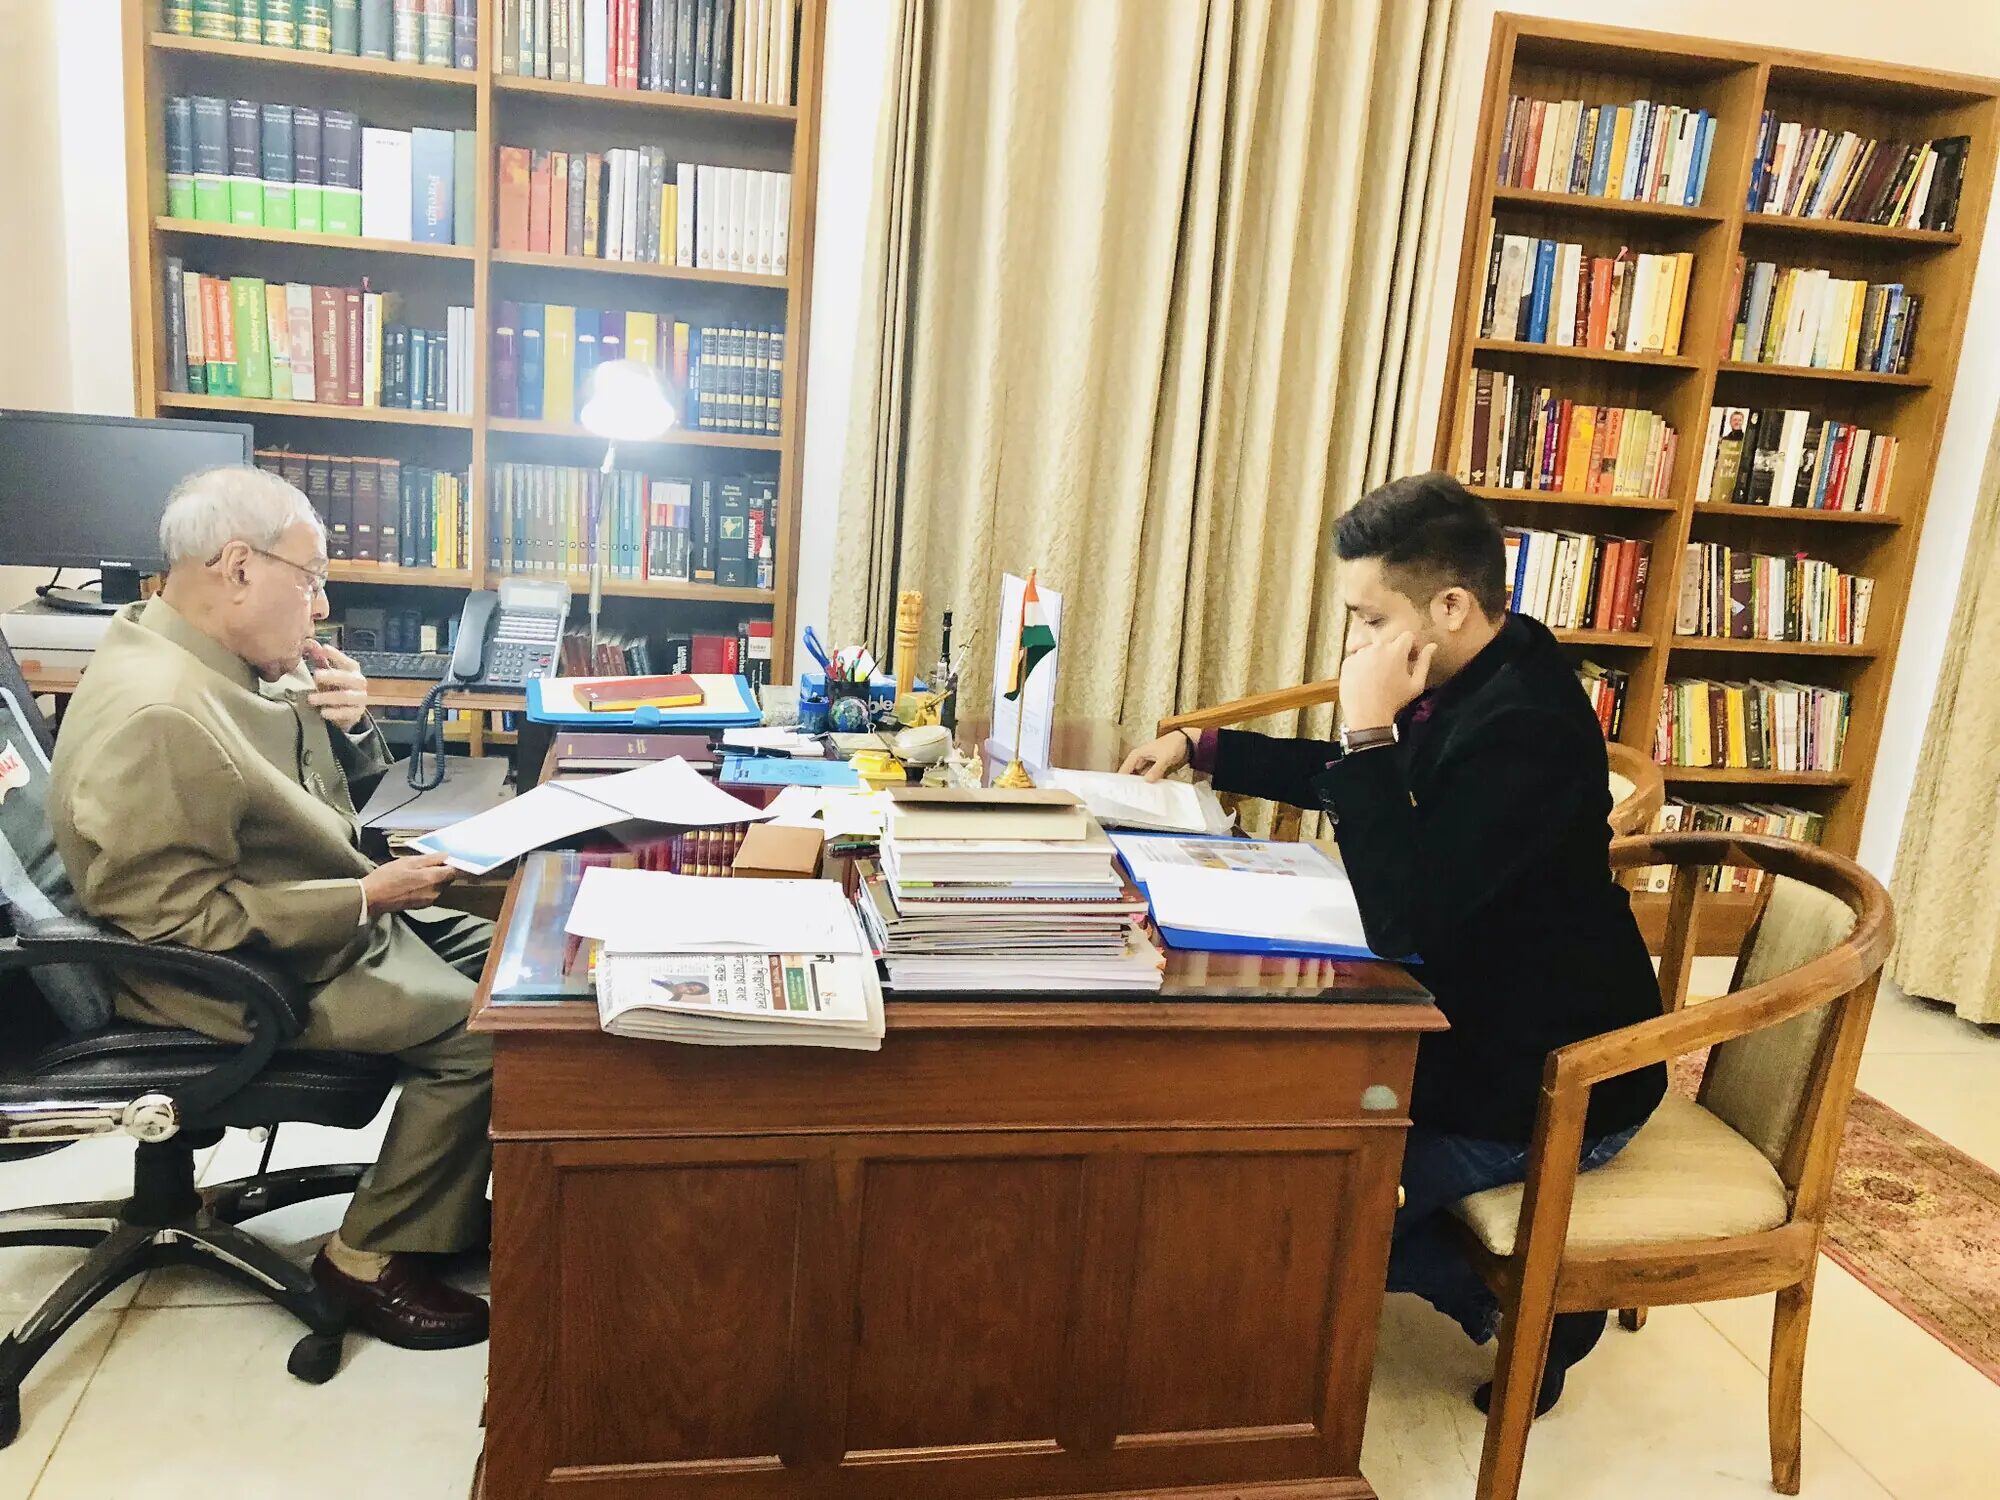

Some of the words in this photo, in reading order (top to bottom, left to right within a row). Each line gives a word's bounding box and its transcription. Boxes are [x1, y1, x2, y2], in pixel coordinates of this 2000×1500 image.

[1610, 411, 1618, 435] GORA
[1720, 469, 1735, 478] Life
[1724, 459, 1736, 471] My
[747, 518, 755, 559] REVOLUTION
[1636, 556, 1648, 584] INDIA
[738, 638, 746, 673] speeches
